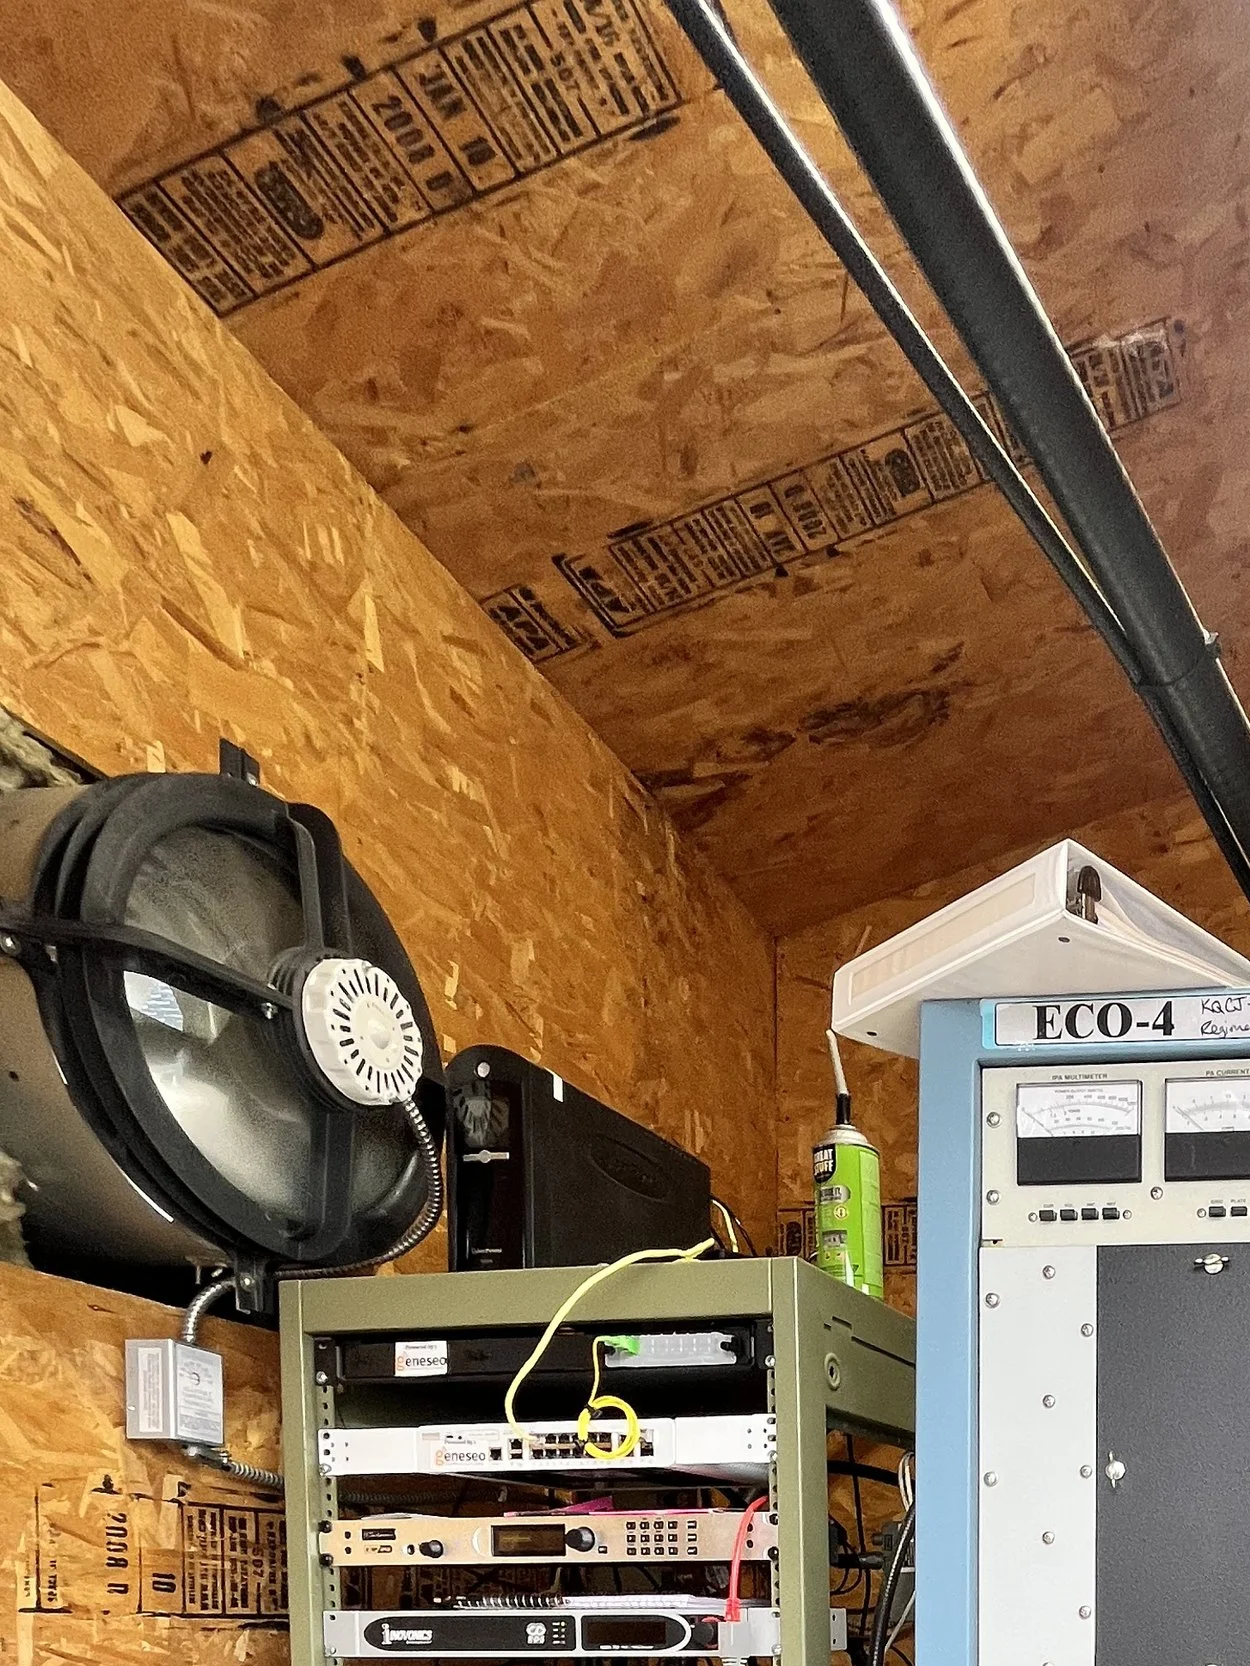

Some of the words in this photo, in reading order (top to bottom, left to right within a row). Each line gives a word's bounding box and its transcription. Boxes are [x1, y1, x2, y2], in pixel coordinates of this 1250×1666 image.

[1033, 1000, 1175, 1040] ECO-4
[1216, 1068, 1250, 1076] CURRENT
[396, 1355, 448, 1372] geneseo
[435, 1449, 486, 1467] geneseo
